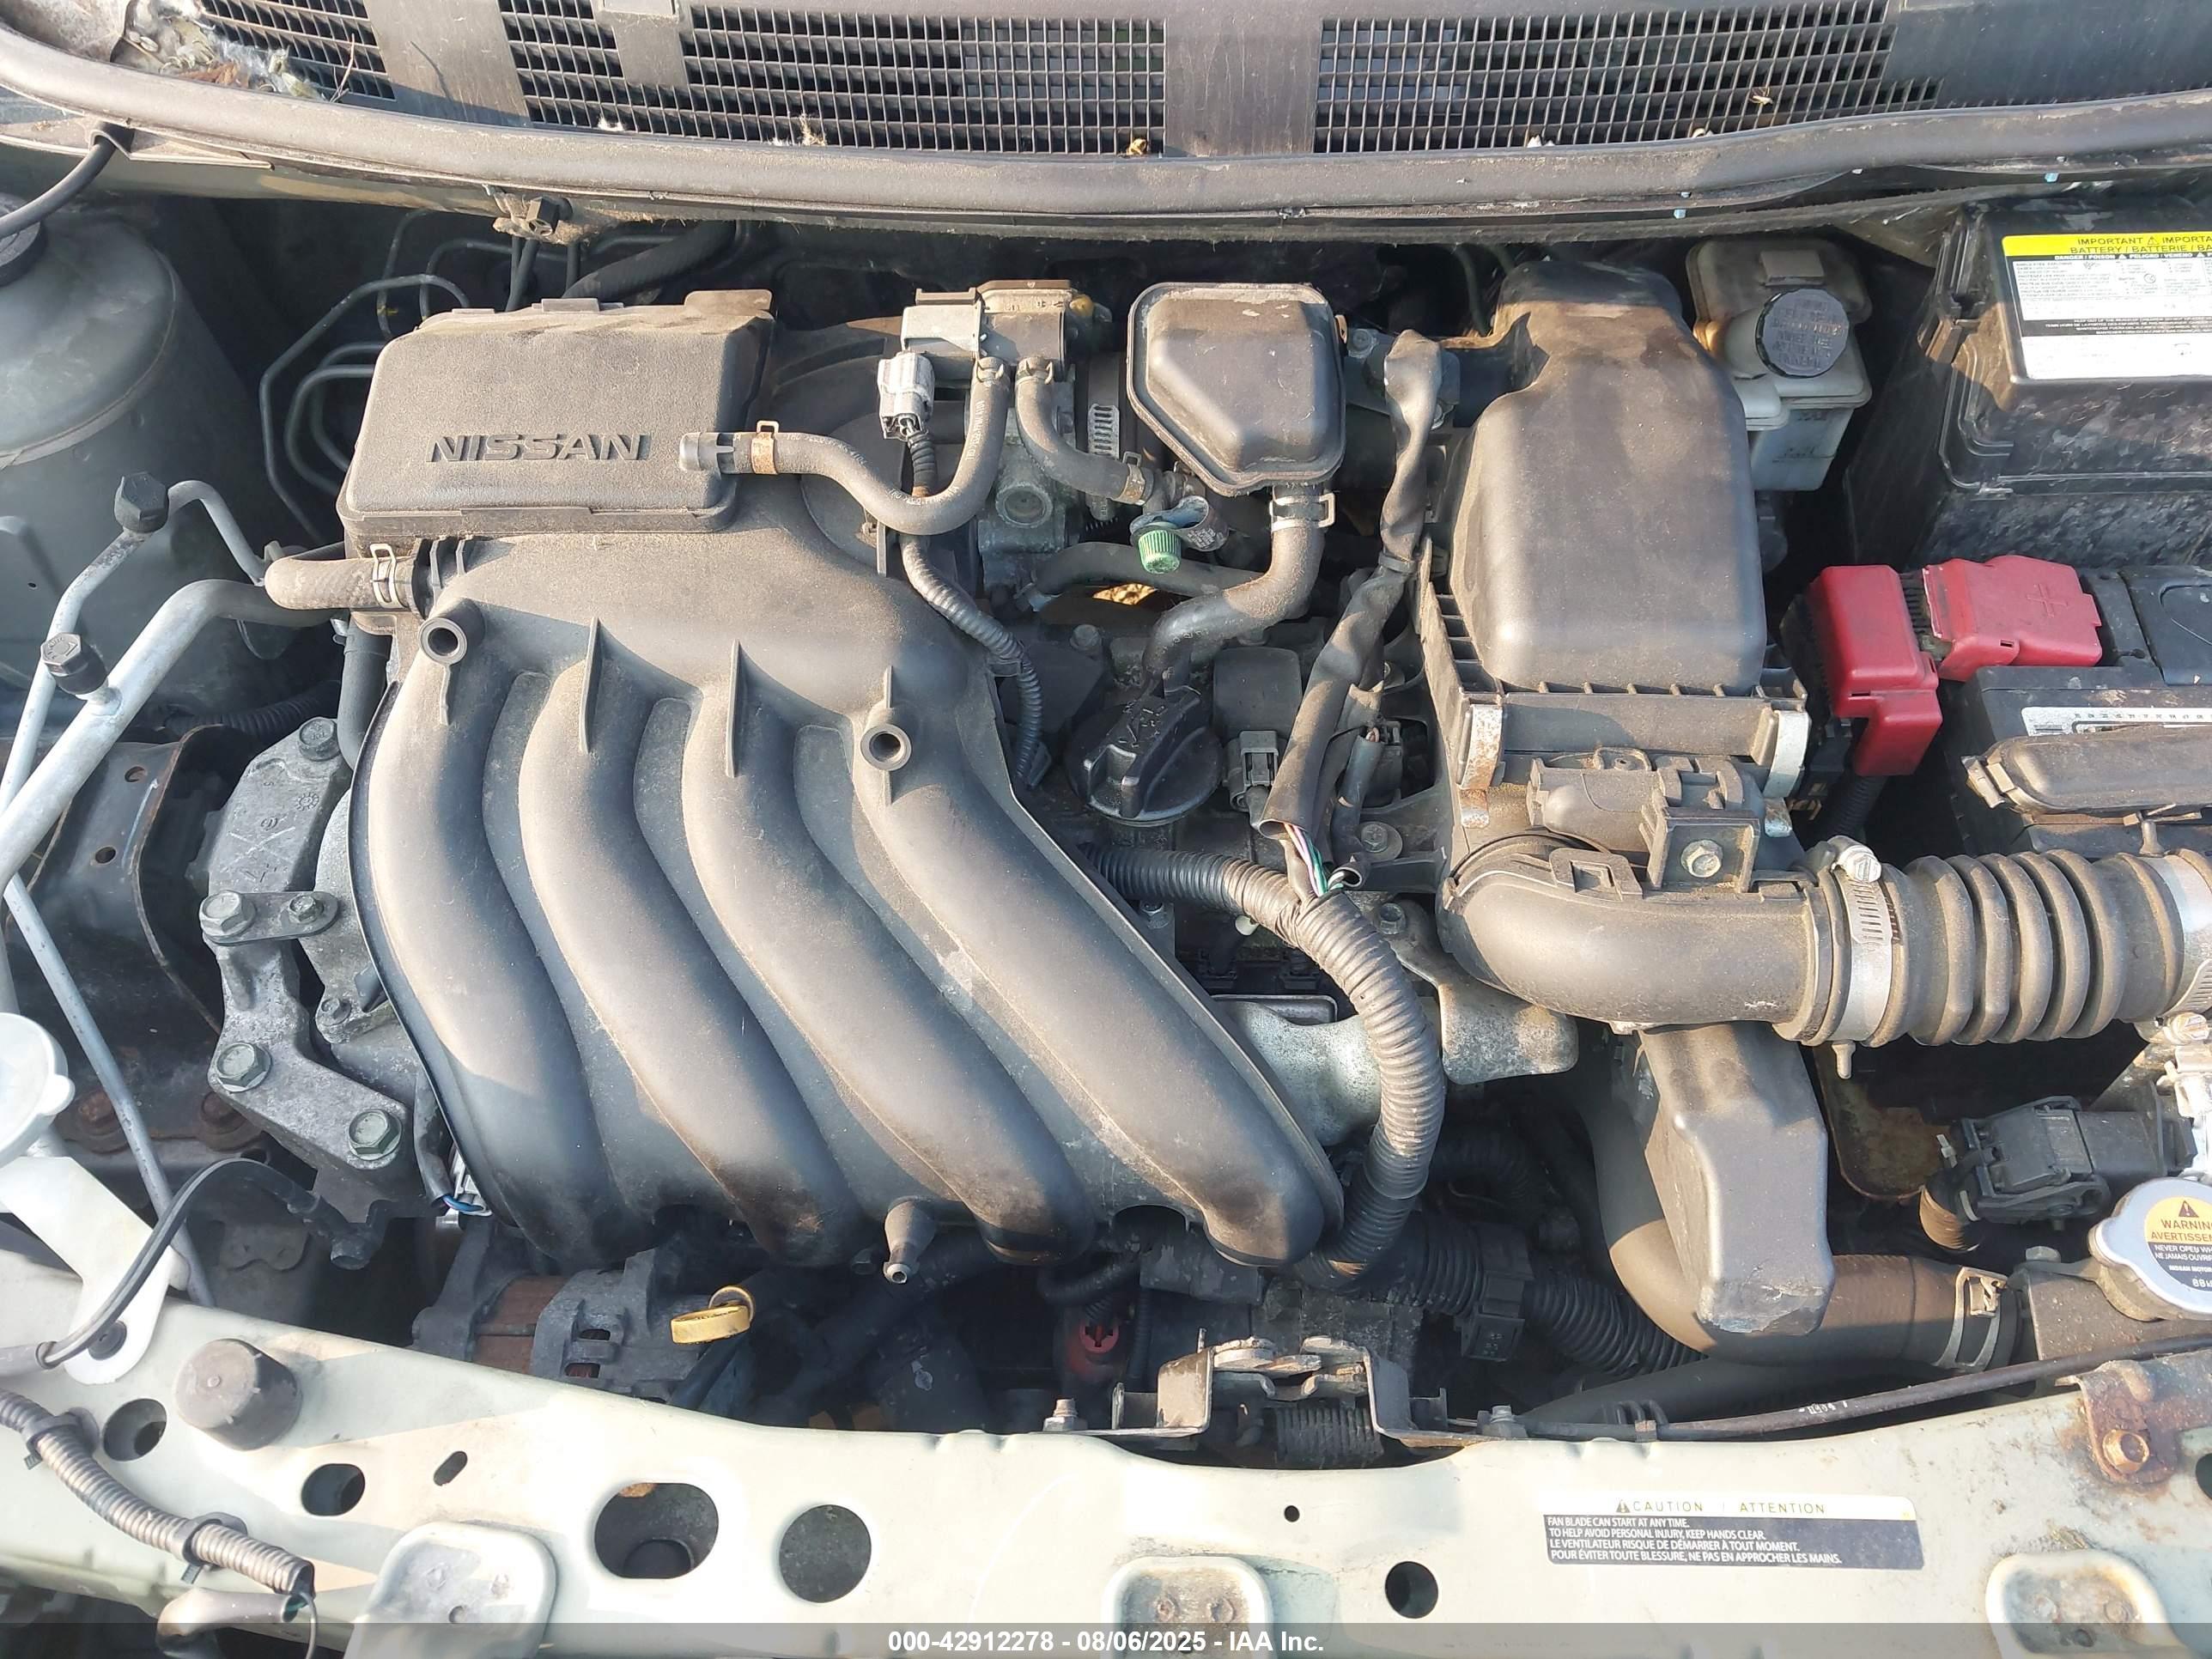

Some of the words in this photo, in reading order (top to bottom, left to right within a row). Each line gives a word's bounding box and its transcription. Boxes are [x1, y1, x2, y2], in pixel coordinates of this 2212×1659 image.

[2132, 244, 2188, 252] BATTERIE
[426, 433, 651, 463] NISSAN
[2160, 1218, 2212, 1231] WARNIN
[1633, 1502, 1703, 1512] CAUTION
[1740, 1503, 1825, 1514] ATTENTION
[1547, 1517, 1564, 1527] FAN
[1565, 1517, 1592, 1527] BLADE
[1593, 1518, 1612, 1527] CAN
[1613, 1518, 1637, 1527] START
[1638, 1518, 1649, 1527] AT
[1650, 1518, 1667, 1527] ANY
[1550, 1528, 1561, 1537] TO
[1563, 1528, 1583, 1538] HELP
[1584, 1528, 1611, 1538] AVOID
[1612, 1529, 1654, 1539] PERSONAL
[1655, 1529, 1685, 1540] INJURY,
[1686, 1530, 1706, 1539] KEEP
[1707, 1530, 1737, 1540] HANDS
[1550, 1539, 1561, 1548] LE
[1563, 1539, 1620, 1549] VENTILATEUR
[1622, 1540, 1656, 1550] RISQUE
[1658, 1540, 1670, 1549] DE
[1671, 1539, 1721, 1551] DÉMARRER
[1722, 1539, 1730, 1551] À
[1730, 1540, 1755, 1551] TOUT
[1756, 1541, 1801, 1552] MOMENT.
[1552, 1550, 1577, 1560] POUR
[1578, 1548, 1609, 1560] ÉVITER
[1609, 1551, 1639, 1560] TOUTE
[1641, 1551, 1687, 1562] BLESSURE,
[1689, 1552, 1702, 1561] NE
[1703, 1552, 1720, 1561] PAS
[1721, 1553, 1734, 1562] EN
[1735, 1553, 1791, 1563] APPROCHER
[1792, 1553, 1807, 1563] LES
[1809, 1553, 1842, 1564] MAINS.
